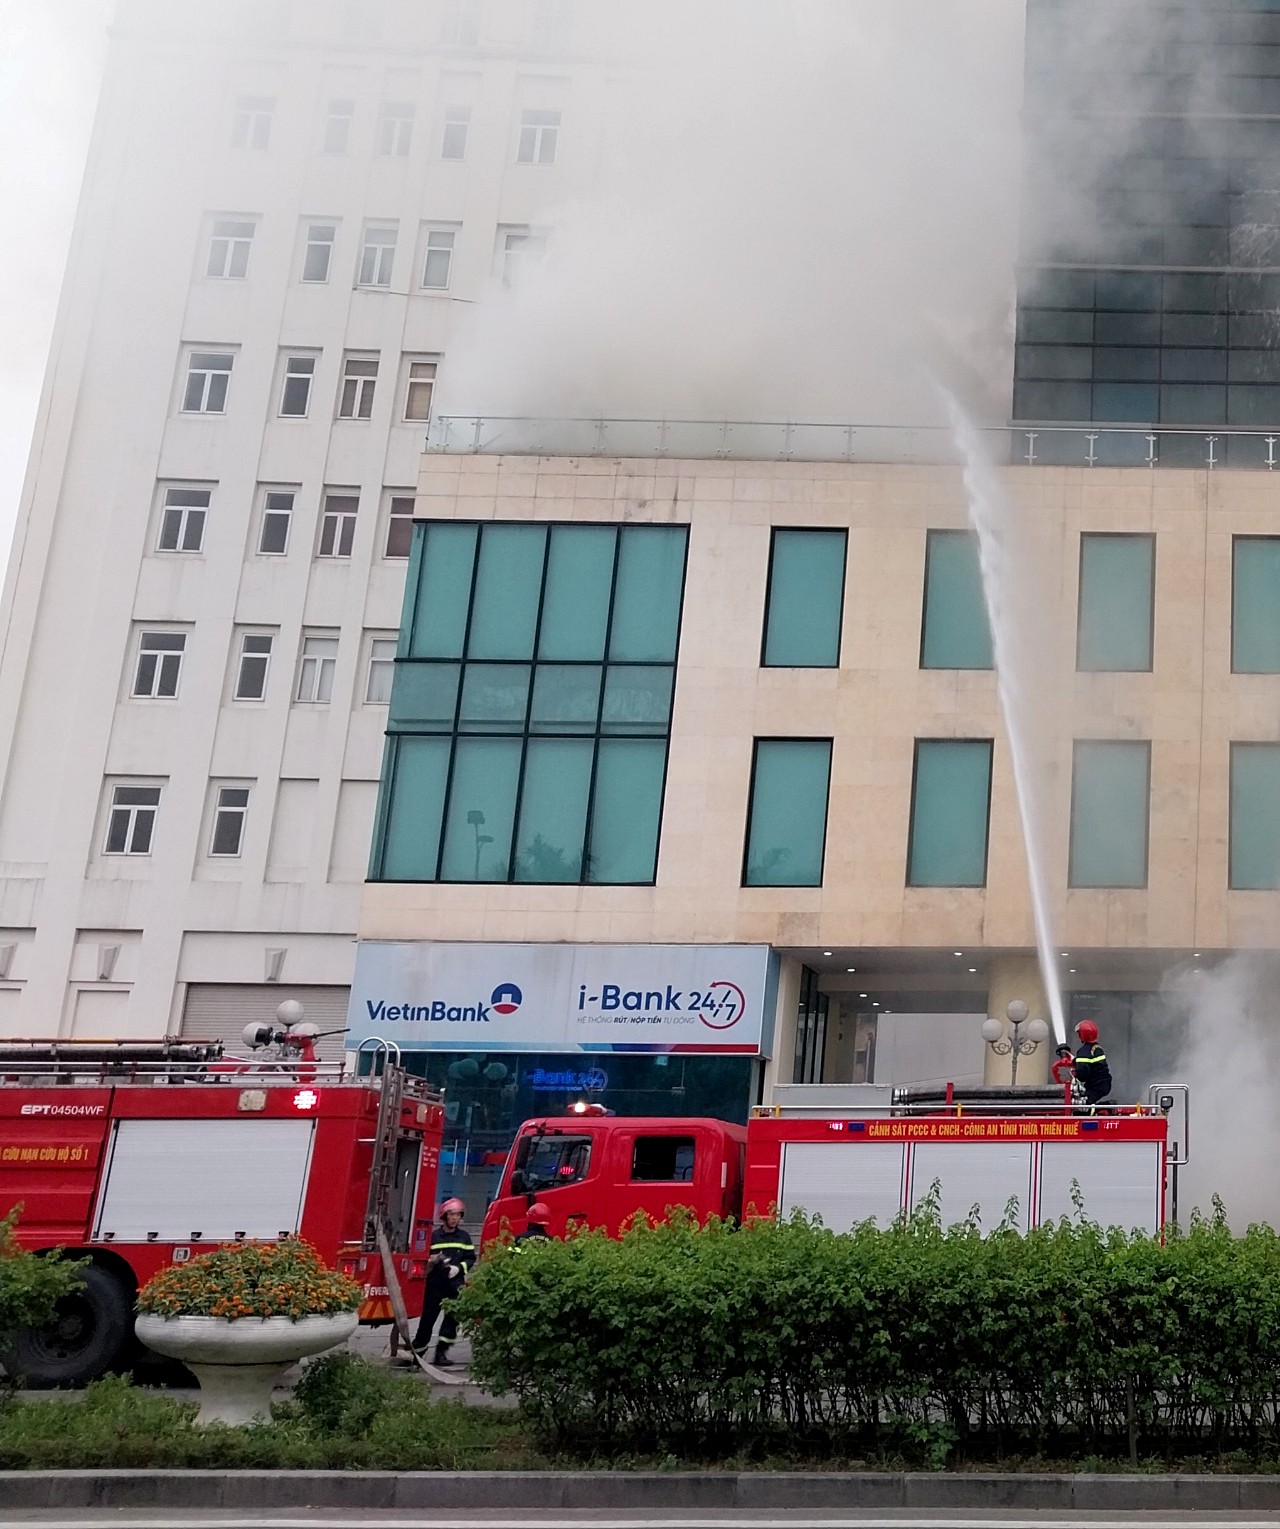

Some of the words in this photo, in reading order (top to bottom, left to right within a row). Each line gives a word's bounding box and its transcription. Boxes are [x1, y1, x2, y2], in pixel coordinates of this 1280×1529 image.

[577, 985, 683, 1011] i-Bank
[366, 1000, 490, 1022] VietinBank
[21, 1105, 104, 1115] EPT04504WF
[869, 1121, 890, 1136] CẢNH
[891, 1122, 907, 1136] SÁT
[908, 1124, 929, 1136] PCCC
[930, 1125, 937, 1136] &
[986, 1124, 998, 1136] AN
[1000, 1121, 1018, 1136] TỈNH
[1019, 1121, 1039, 1136] THỪA
[1040, 1122, 1062, 1136] THIÊN
[1063, 1121, 1079, 1136] HUẾ
[70, 1144, 84, 1161] SỐ
[84, 1148, 89, 1161] 1
